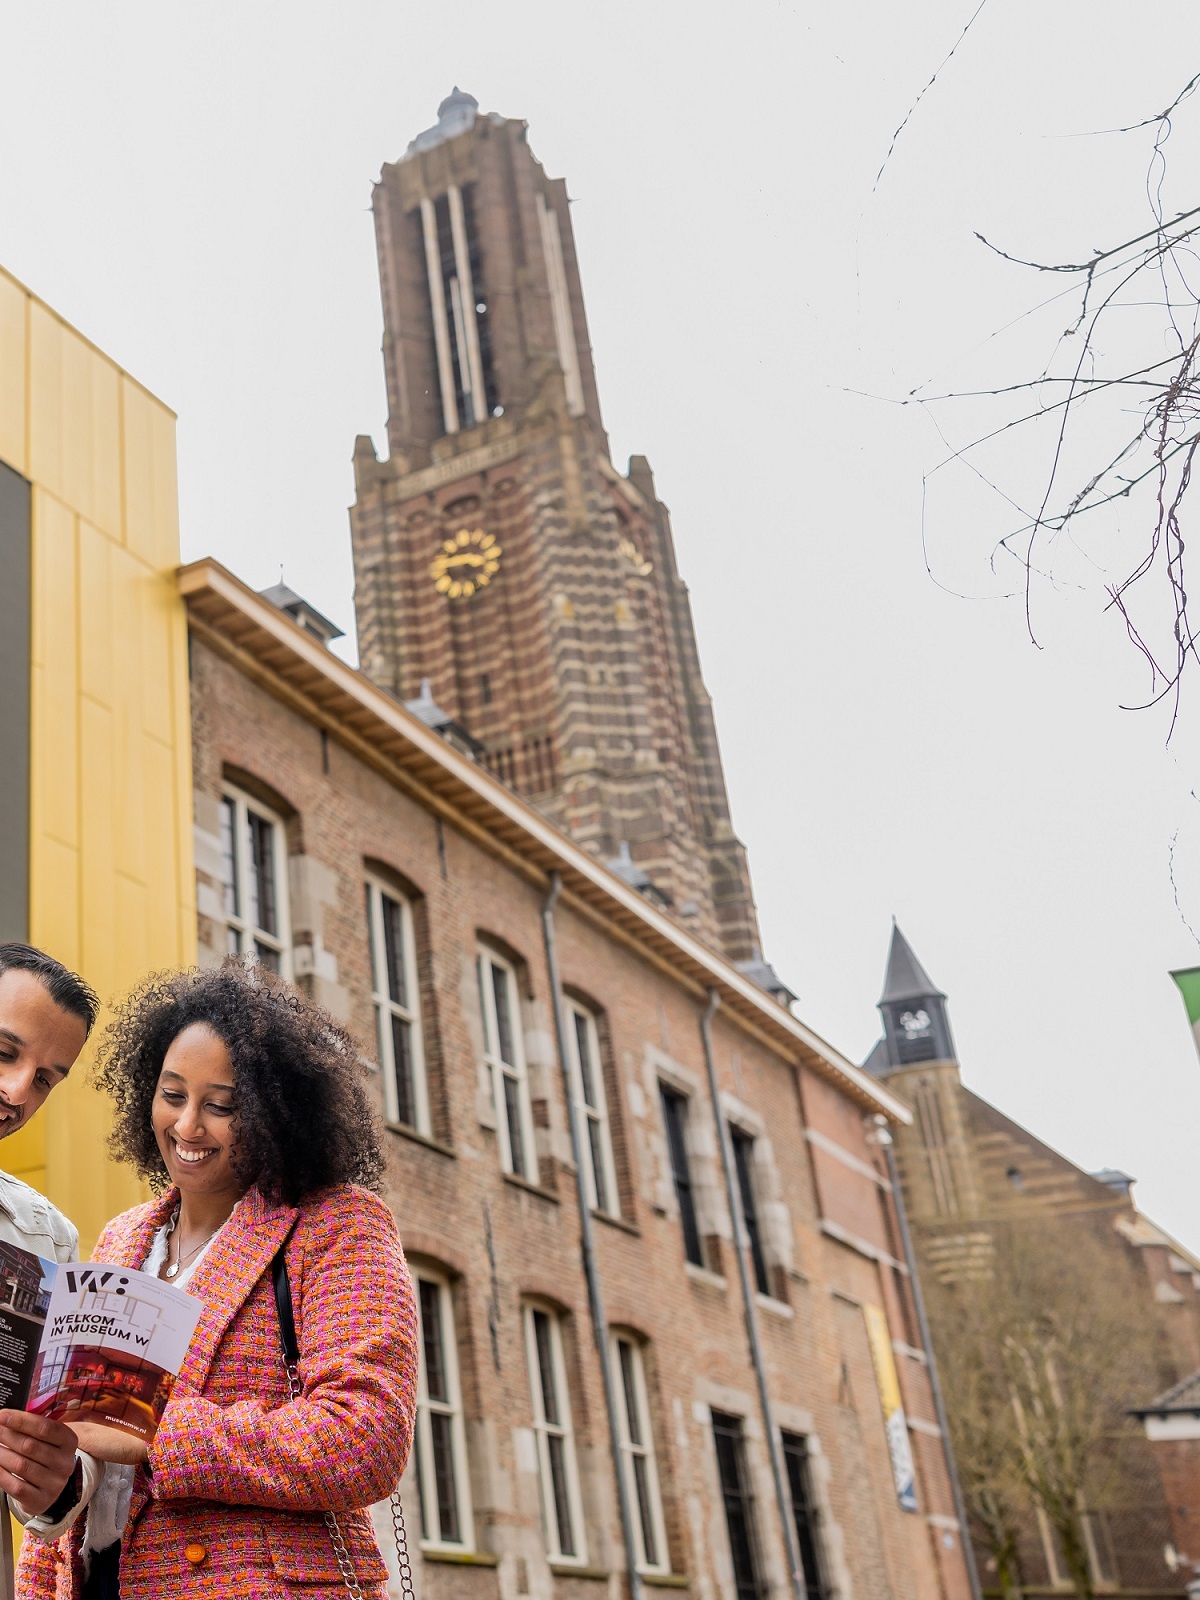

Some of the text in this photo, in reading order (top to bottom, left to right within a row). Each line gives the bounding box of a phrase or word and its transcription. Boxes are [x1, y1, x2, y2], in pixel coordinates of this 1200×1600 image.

[54, 1314, 115, 1326] WELKOM
[50, 1326, 64, 1337] IN
[67, 1324, 131, 1341] MUSEUM
[135, 1334, 149, 1346] W
[105, 1414, 147, 1435] museumw.nl
